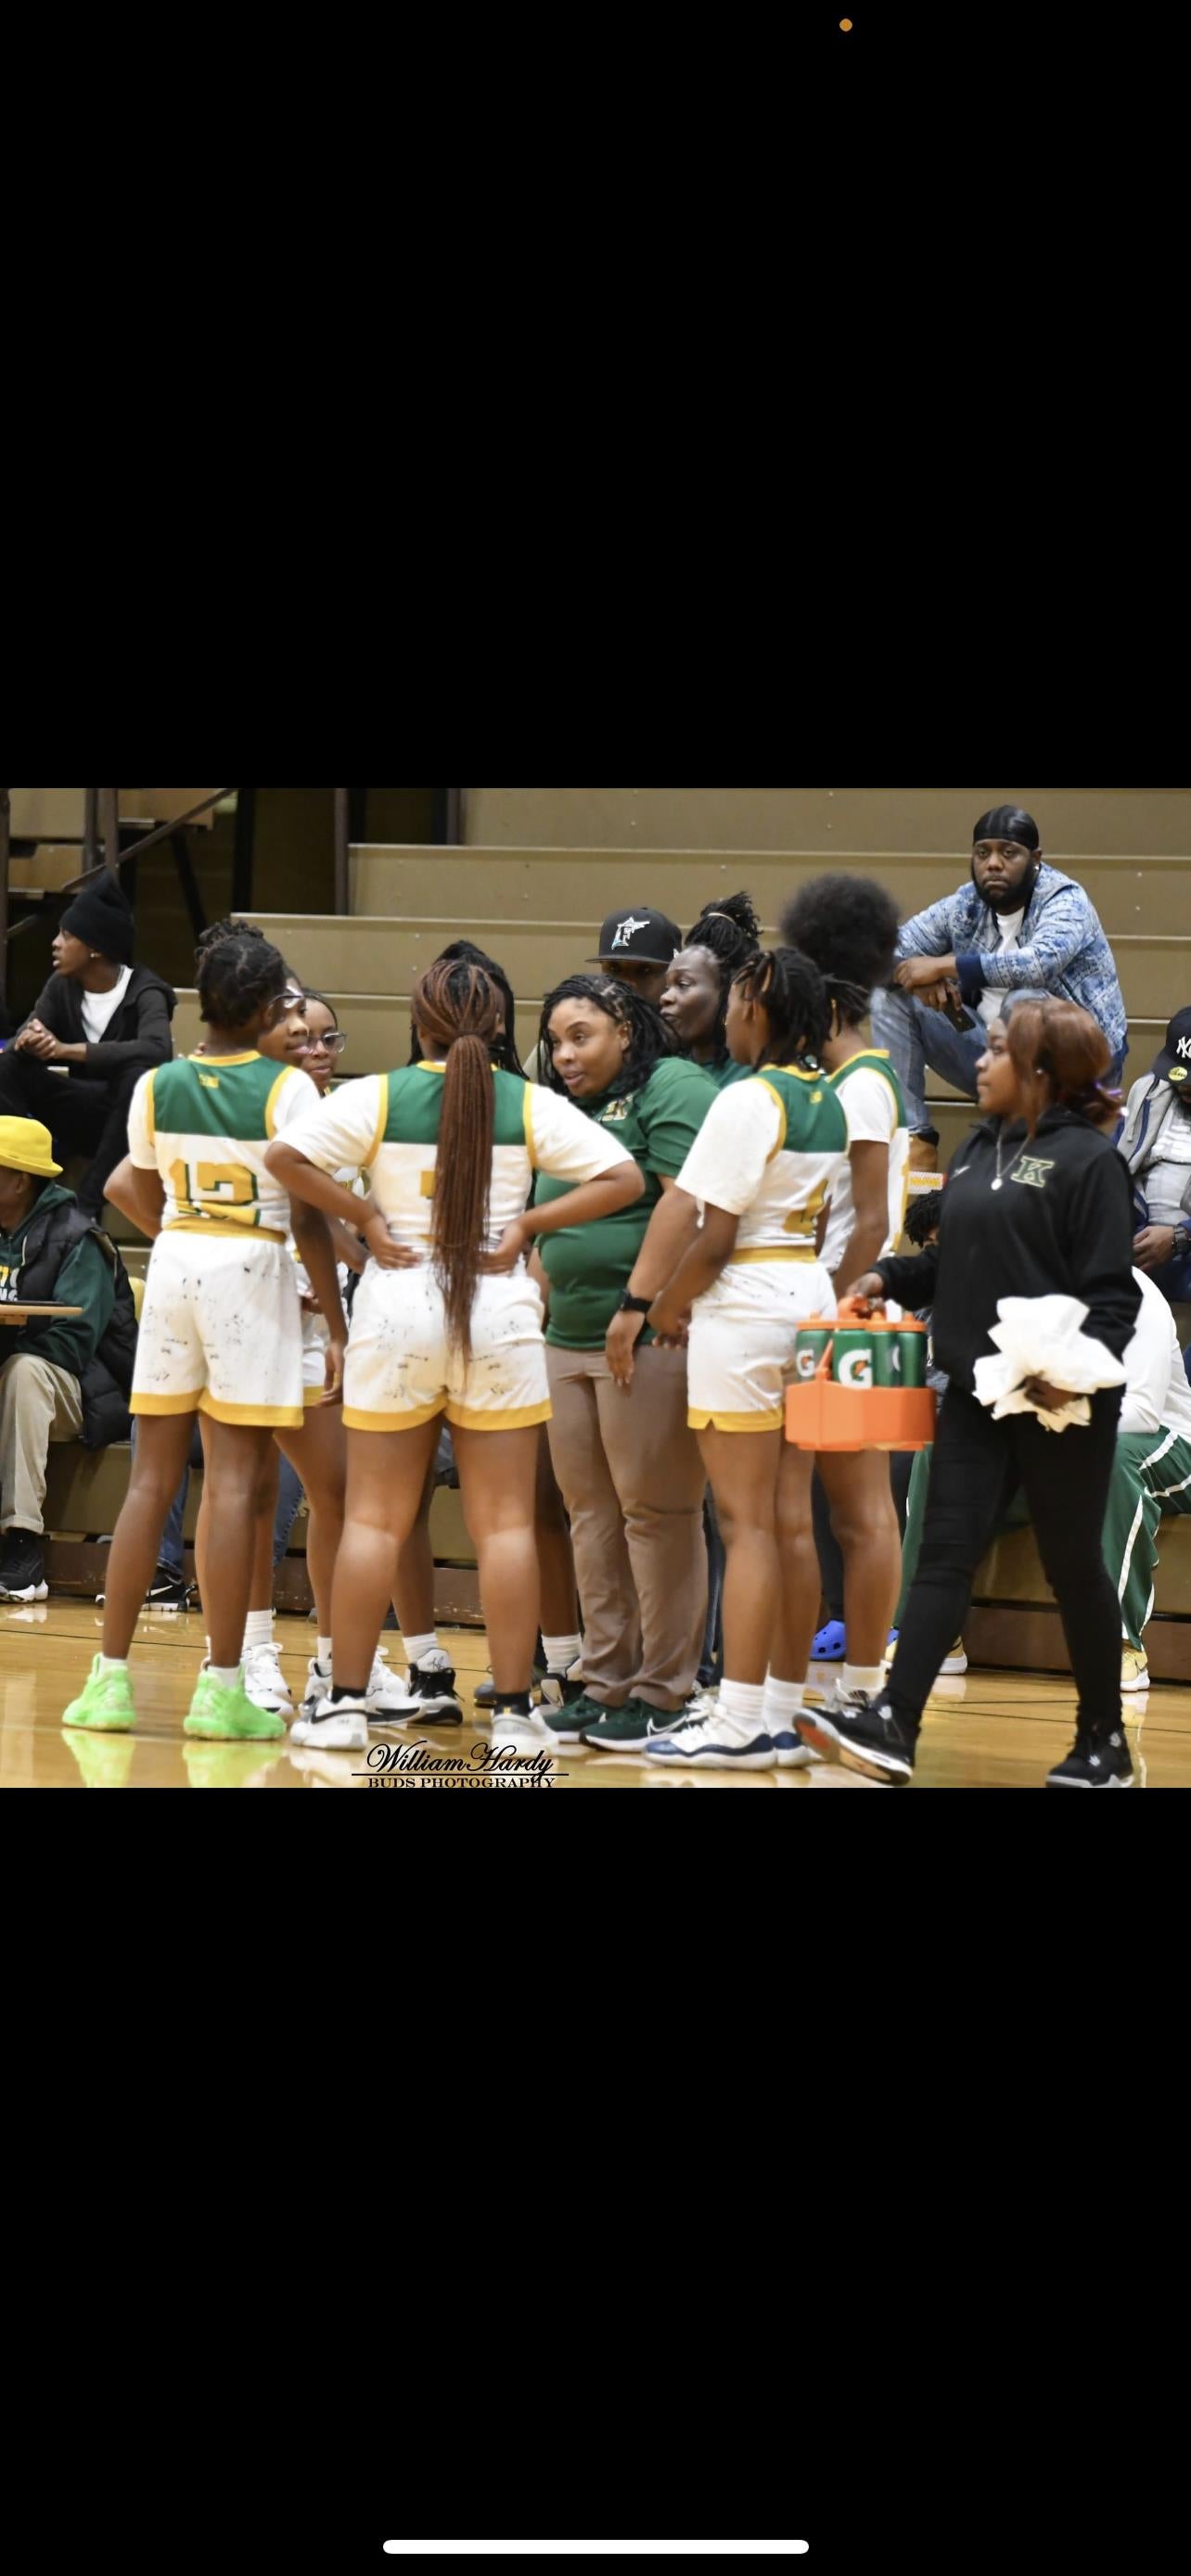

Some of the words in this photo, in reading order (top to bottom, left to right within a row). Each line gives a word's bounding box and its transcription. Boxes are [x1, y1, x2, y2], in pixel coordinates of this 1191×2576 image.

[1010, 1155, 1055, 1188] K
[797, 1349, 815, 1377] G
[839, 1349, 873, 1389] G
